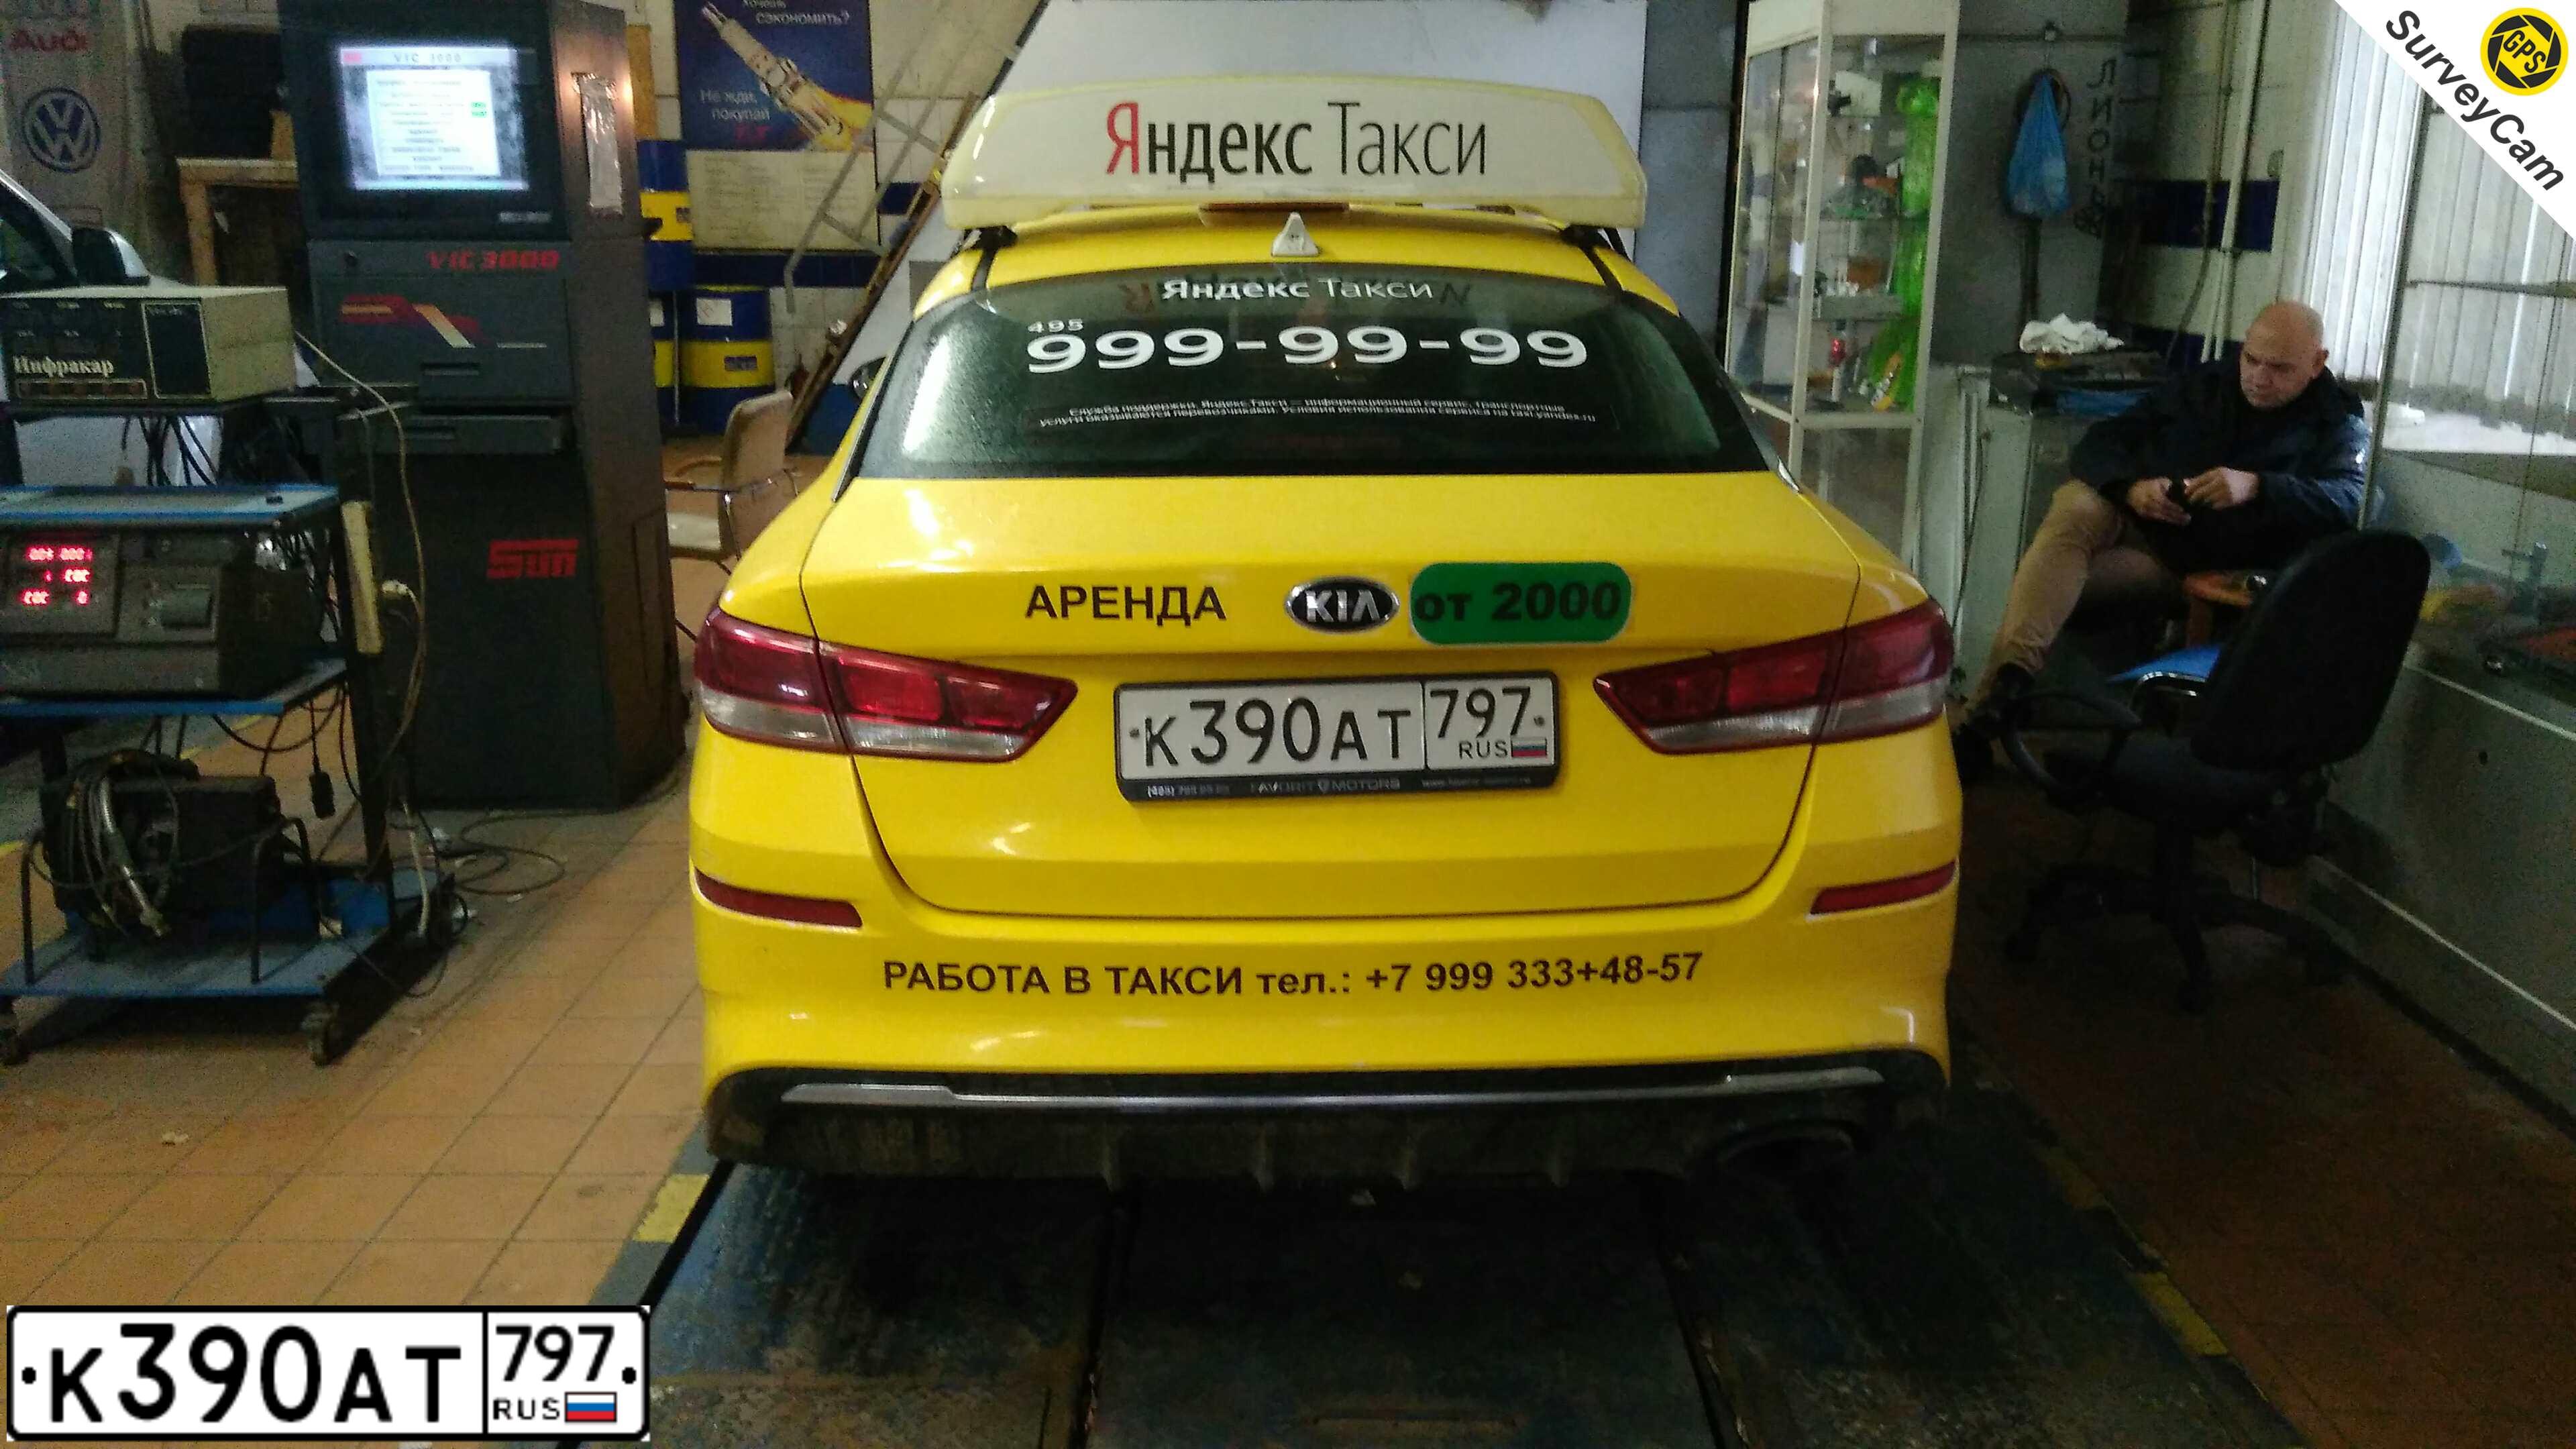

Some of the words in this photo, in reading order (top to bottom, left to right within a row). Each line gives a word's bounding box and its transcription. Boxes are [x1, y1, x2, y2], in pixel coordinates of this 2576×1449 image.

[1106, 101, 1313, 183] Яндекс
[1326, 101, 1487, 177] Такси
[482, 249, 559, 270] 3000
[1161, 278, 1309, 301] Яндекс
[1318, 276, 1434, 300] Такси
[1028, 319, 1085, 332] 495
[13, 355, 114, 377] Инфракар
[1027, 325, 1589, 374] 999-99-99
[1024, 585, 1227, 627] АРЕНДА
[1303, 588, 1386, 624] KIA
[1415, 589, 1472, 624] от
[1490, 580, 1621, 622] 2000
[1144, 696, 1411, 767] К390АТ
[1430, 686, 1532, 739] 797
[1458, 738, 1509, 759] RUS
[883, 960, 1051, 994] РАБОТА
[1064, 966, 1091, 994] В
[1104, 965, 1242, 995] ТАКСИ
[1256, 970, 1351, 995] тел.:
[1365, 962, 1412, 992] +7
[1425, 961, 1494, 991] 999
[1507, 951, 1704, 989] 333+48-57
